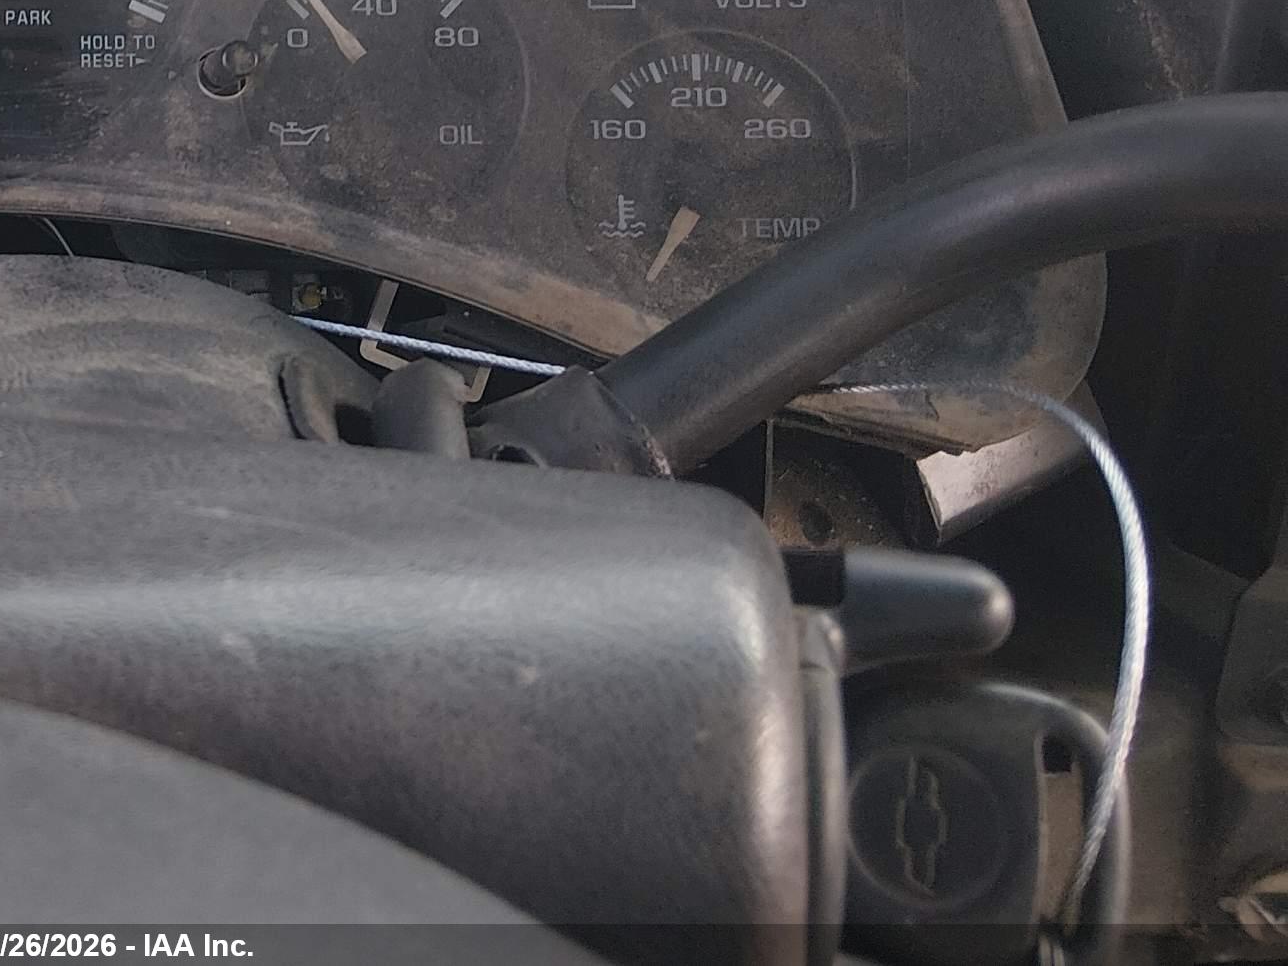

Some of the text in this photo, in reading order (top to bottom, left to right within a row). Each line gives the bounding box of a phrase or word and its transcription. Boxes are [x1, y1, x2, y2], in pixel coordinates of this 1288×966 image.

[5, 10, 52, 26] PARK
[80, 35, 156, 51] HOLD TO
[287, 28, 309, 48] 0
[435, 27, 479, 47] 80
[80, 53, 135, 68] RESET
[671, 87, 727, 107] 210
[439, 126, 482, 144] OIL
[591, 120, 646, 139] 160
[743, 119, 812, 139] 260
[739, 218, 820, 239] TEMP
